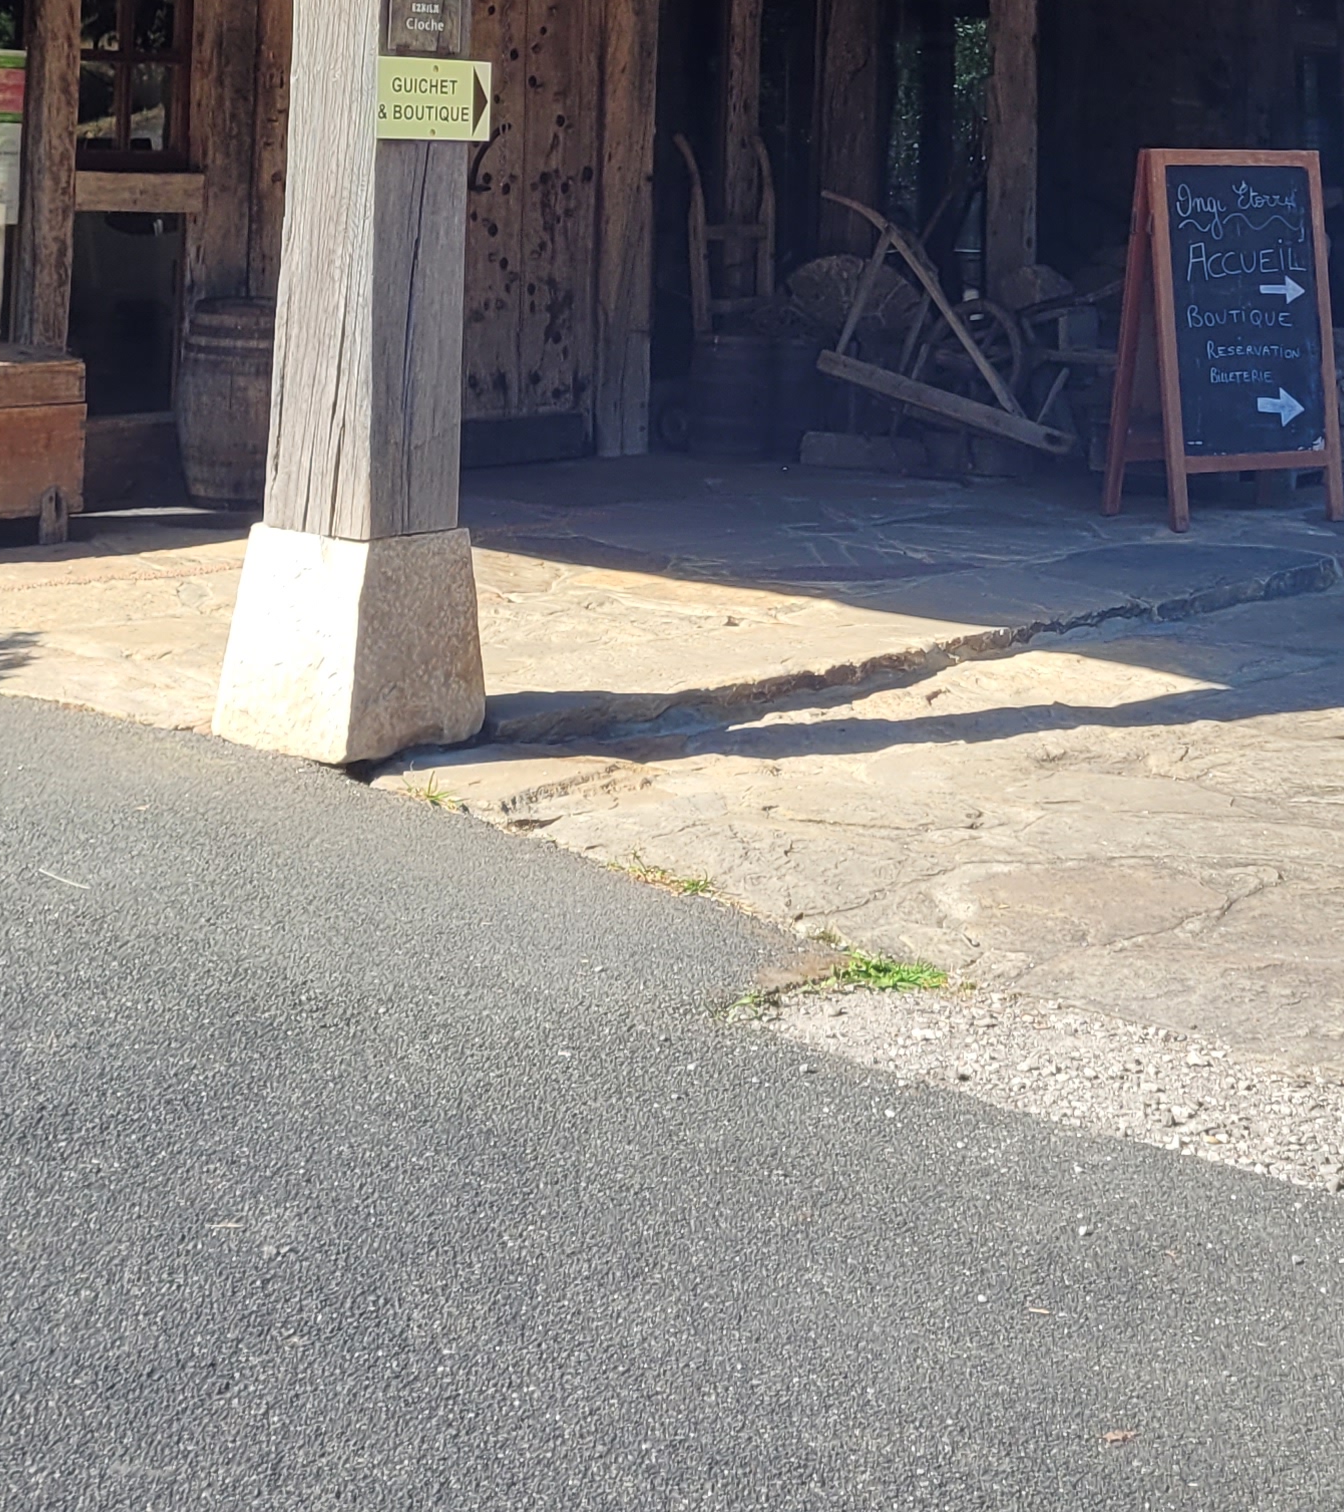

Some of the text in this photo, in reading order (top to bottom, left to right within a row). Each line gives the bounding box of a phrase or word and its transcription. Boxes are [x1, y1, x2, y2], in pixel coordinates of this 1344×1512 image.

[406, 18, 445, 31] Cloche
[392, 76, 458, 95] GUICHET
[378, 103, 469, 122] & BOUTIQUE
